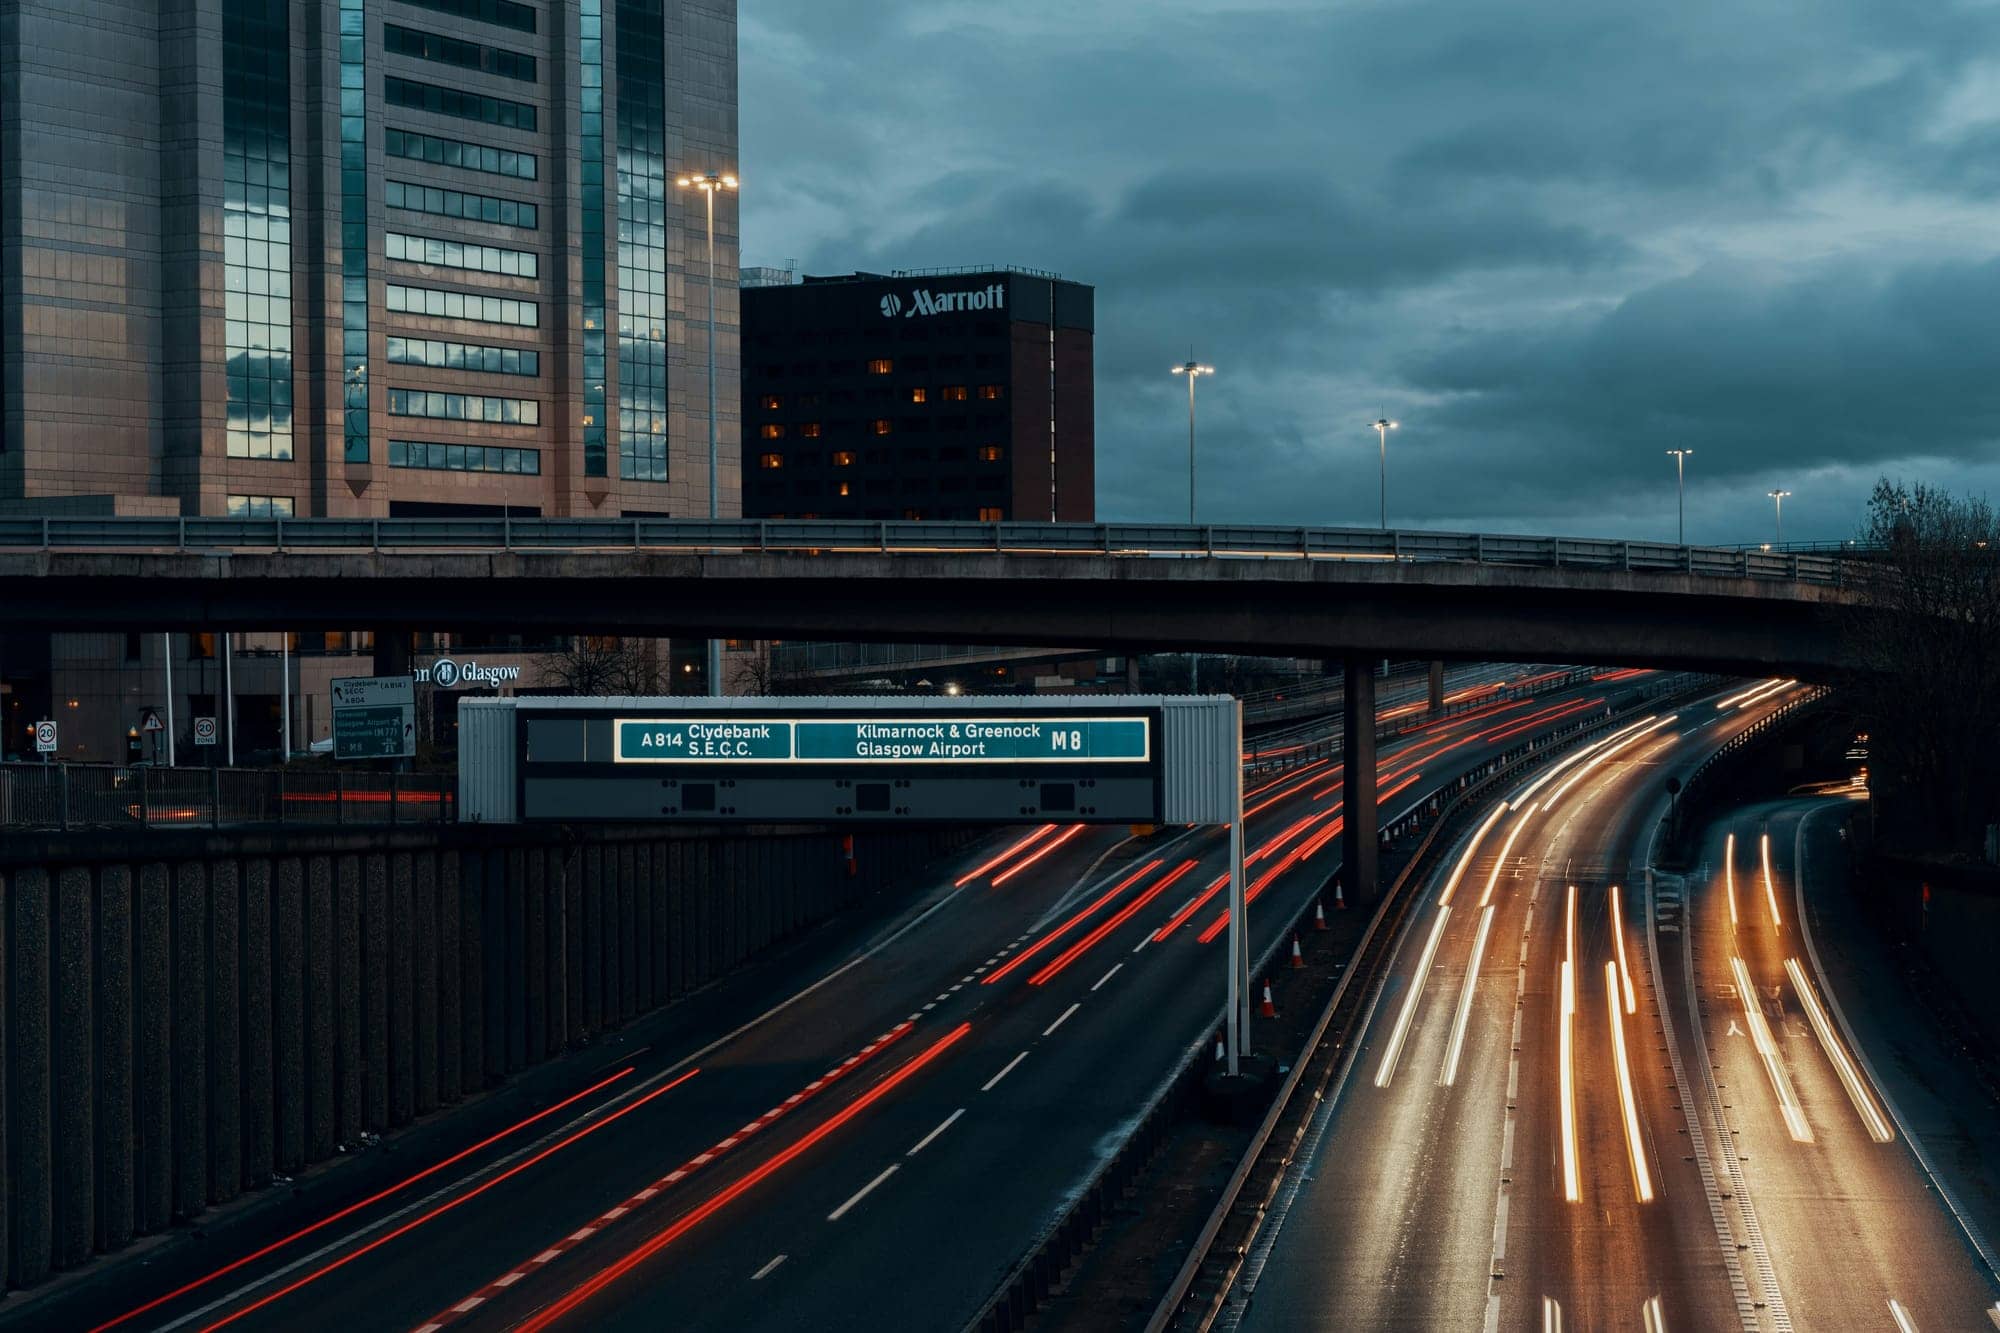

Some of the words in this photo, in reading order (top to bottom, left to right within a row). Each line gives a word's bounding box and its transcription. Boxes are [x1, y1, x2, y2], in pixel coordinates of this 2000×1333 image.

[905, 284, 1005, 317] Marriott
[462, 661, 520, 687] Glasgow
[40, 728, 53, 738] 20
[199, 723, 212, 732] 20
[688, 724, 770, 741] Clydebank
[856, 724, 944, 738] Kilmarnock
[949, 724, 961, 738] &
[965, 723, 1041, 738] Greenock
[688, 741, 752, 756] S.E.C.C.
[856, 741, 924, 757] Glasgow
[929, 741, 985, 757] Airport
